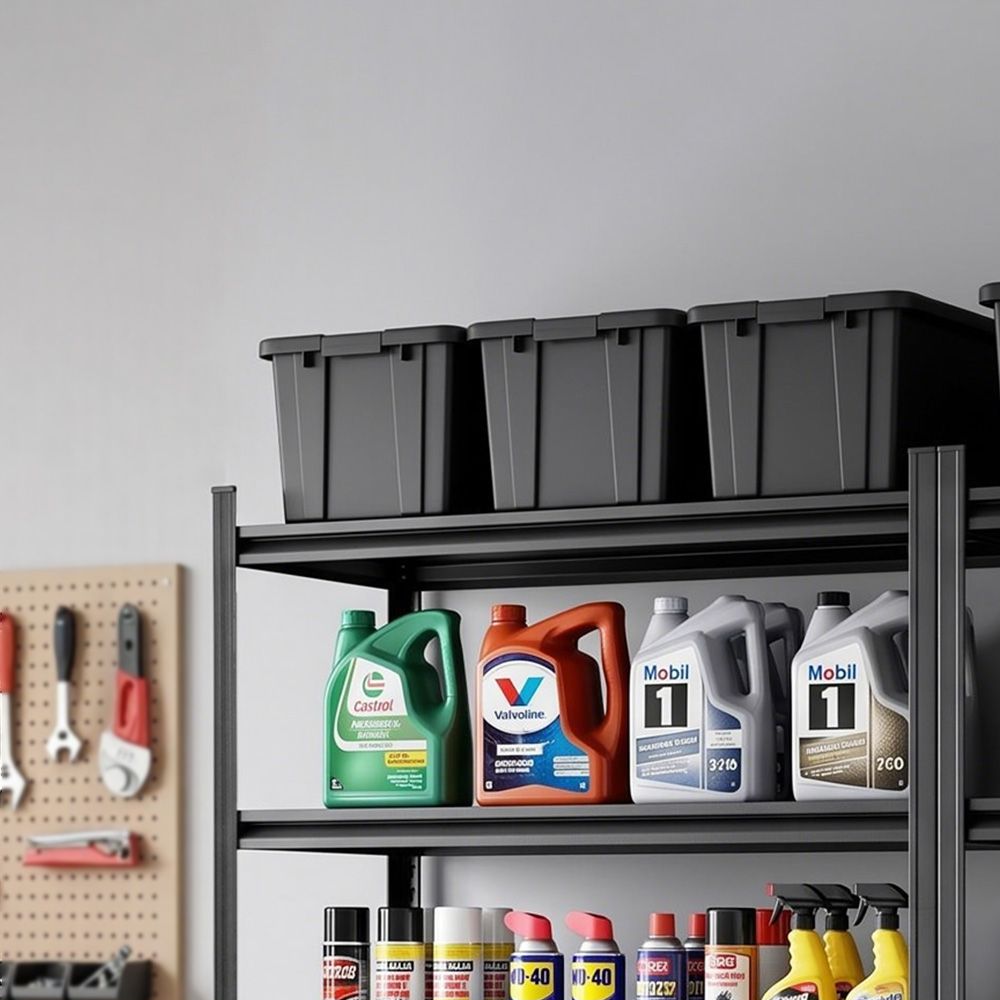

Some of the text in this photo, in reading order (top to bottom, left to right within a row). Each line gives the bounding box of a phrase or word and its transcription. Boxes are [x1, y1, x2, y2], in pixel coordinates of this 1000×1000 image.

[644, 664, 689, 680] Mobil
[808, 664, 856, 680] Mobil
[353, 699, 393, 713] Castrol
[656, 686, 673, 726] 1
[821, 686, 839, 728] 1
[494, 709, 546, 720] Valvoline
